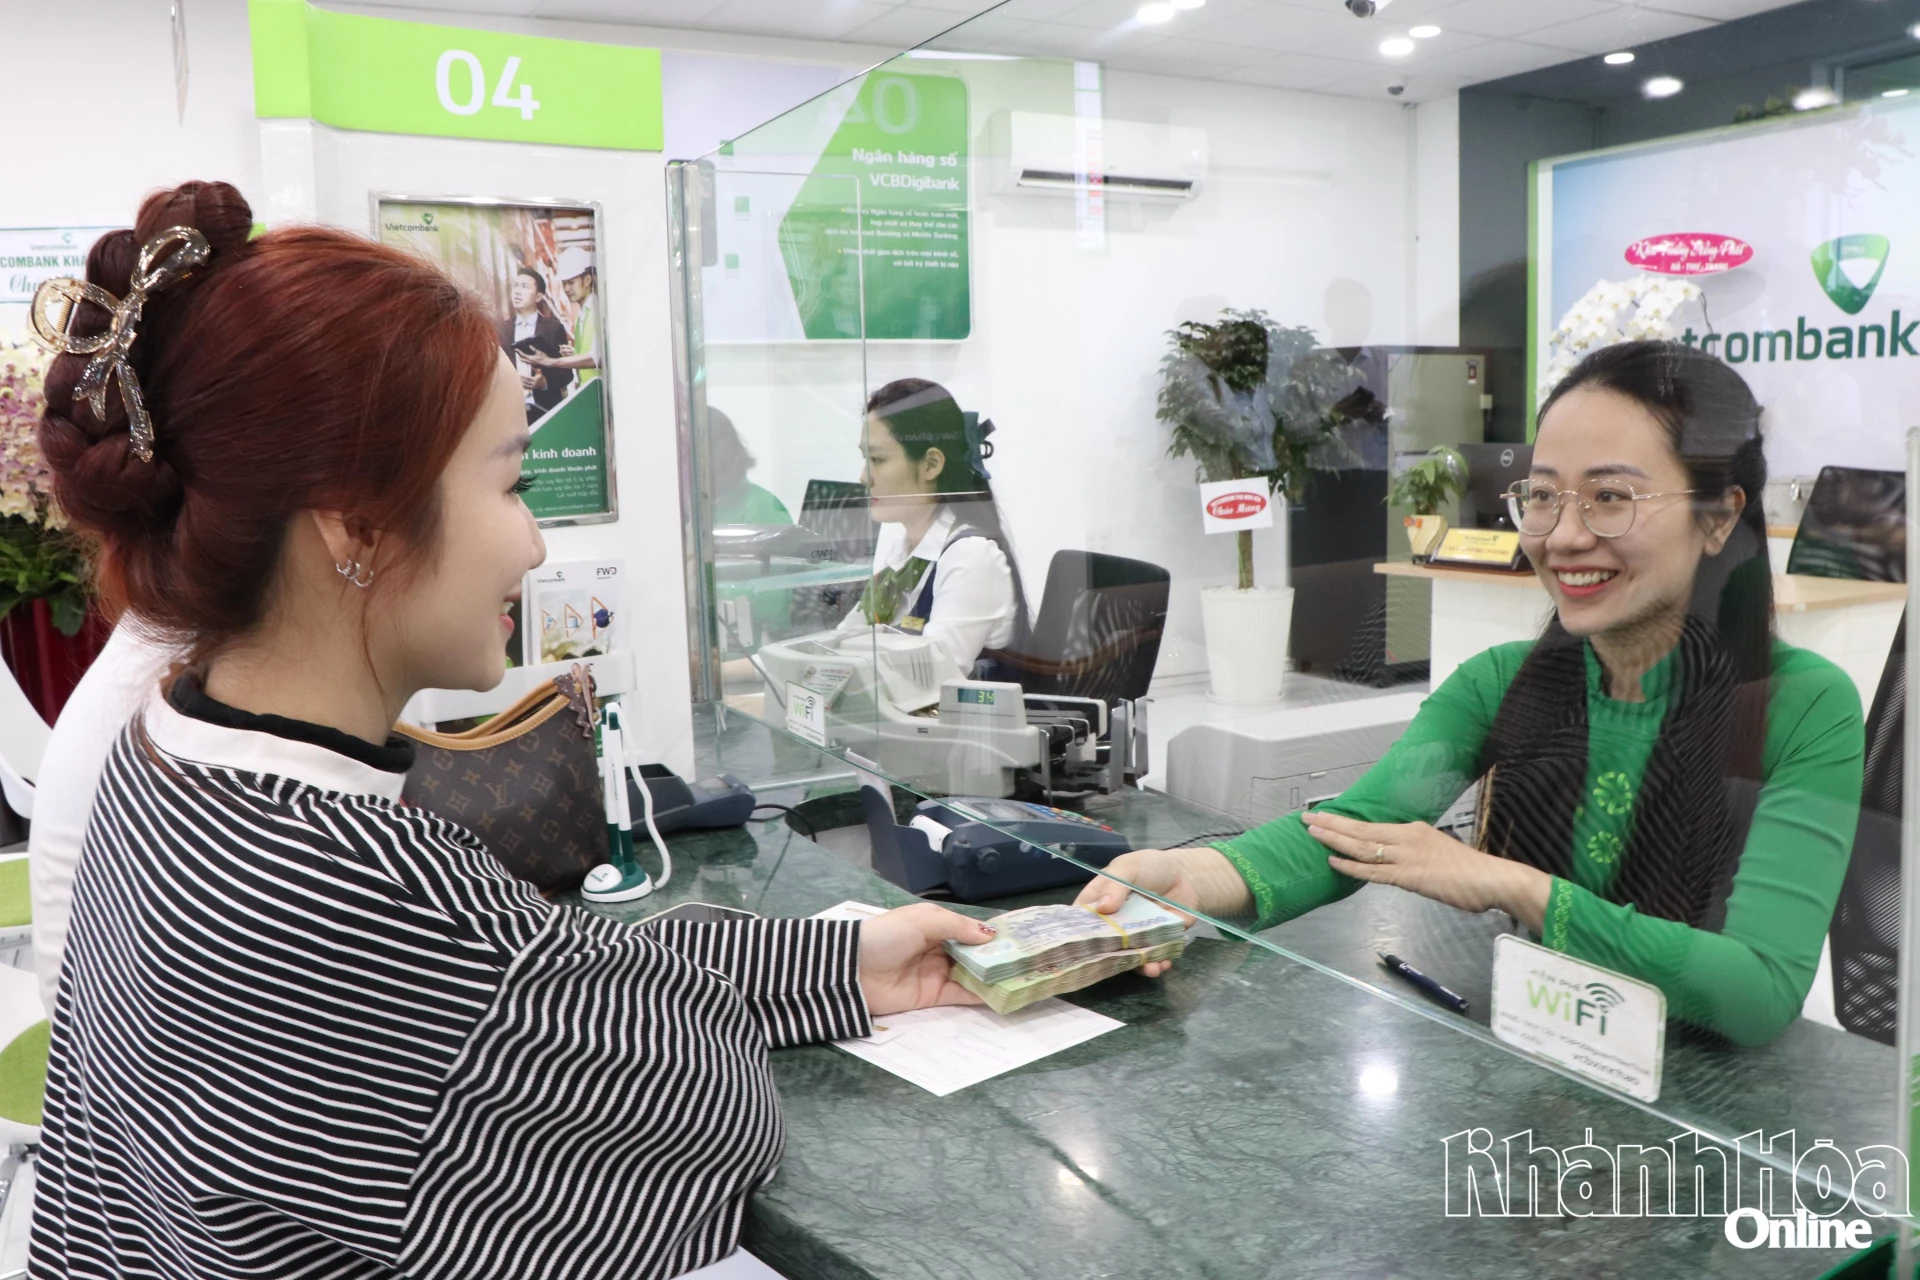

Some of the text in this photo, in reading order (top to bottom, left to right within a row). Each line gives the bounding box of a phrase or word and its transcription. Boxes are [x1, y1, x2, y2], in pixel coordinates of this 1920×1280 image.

[435, 48, 541, 121] 04
[851, 147, 959, 168] Ngân hàng số
[869, 172, 960, 191] VCBDigibank
[385, 223, 440, 232] Vietcombank
[30, 243, 78, 251] Vietcombank
[0, 256, 59, 268] COMBANK
[1677, 309, 1920, 363] tcombank
[532, 448, 558, 459] kinh
[561, 446, 597, 458] doanh
[596, 567, 617, 576] FWD
[978, 691, 994, 703] 34
[1526, 979, 1606, 1036] WiFi
